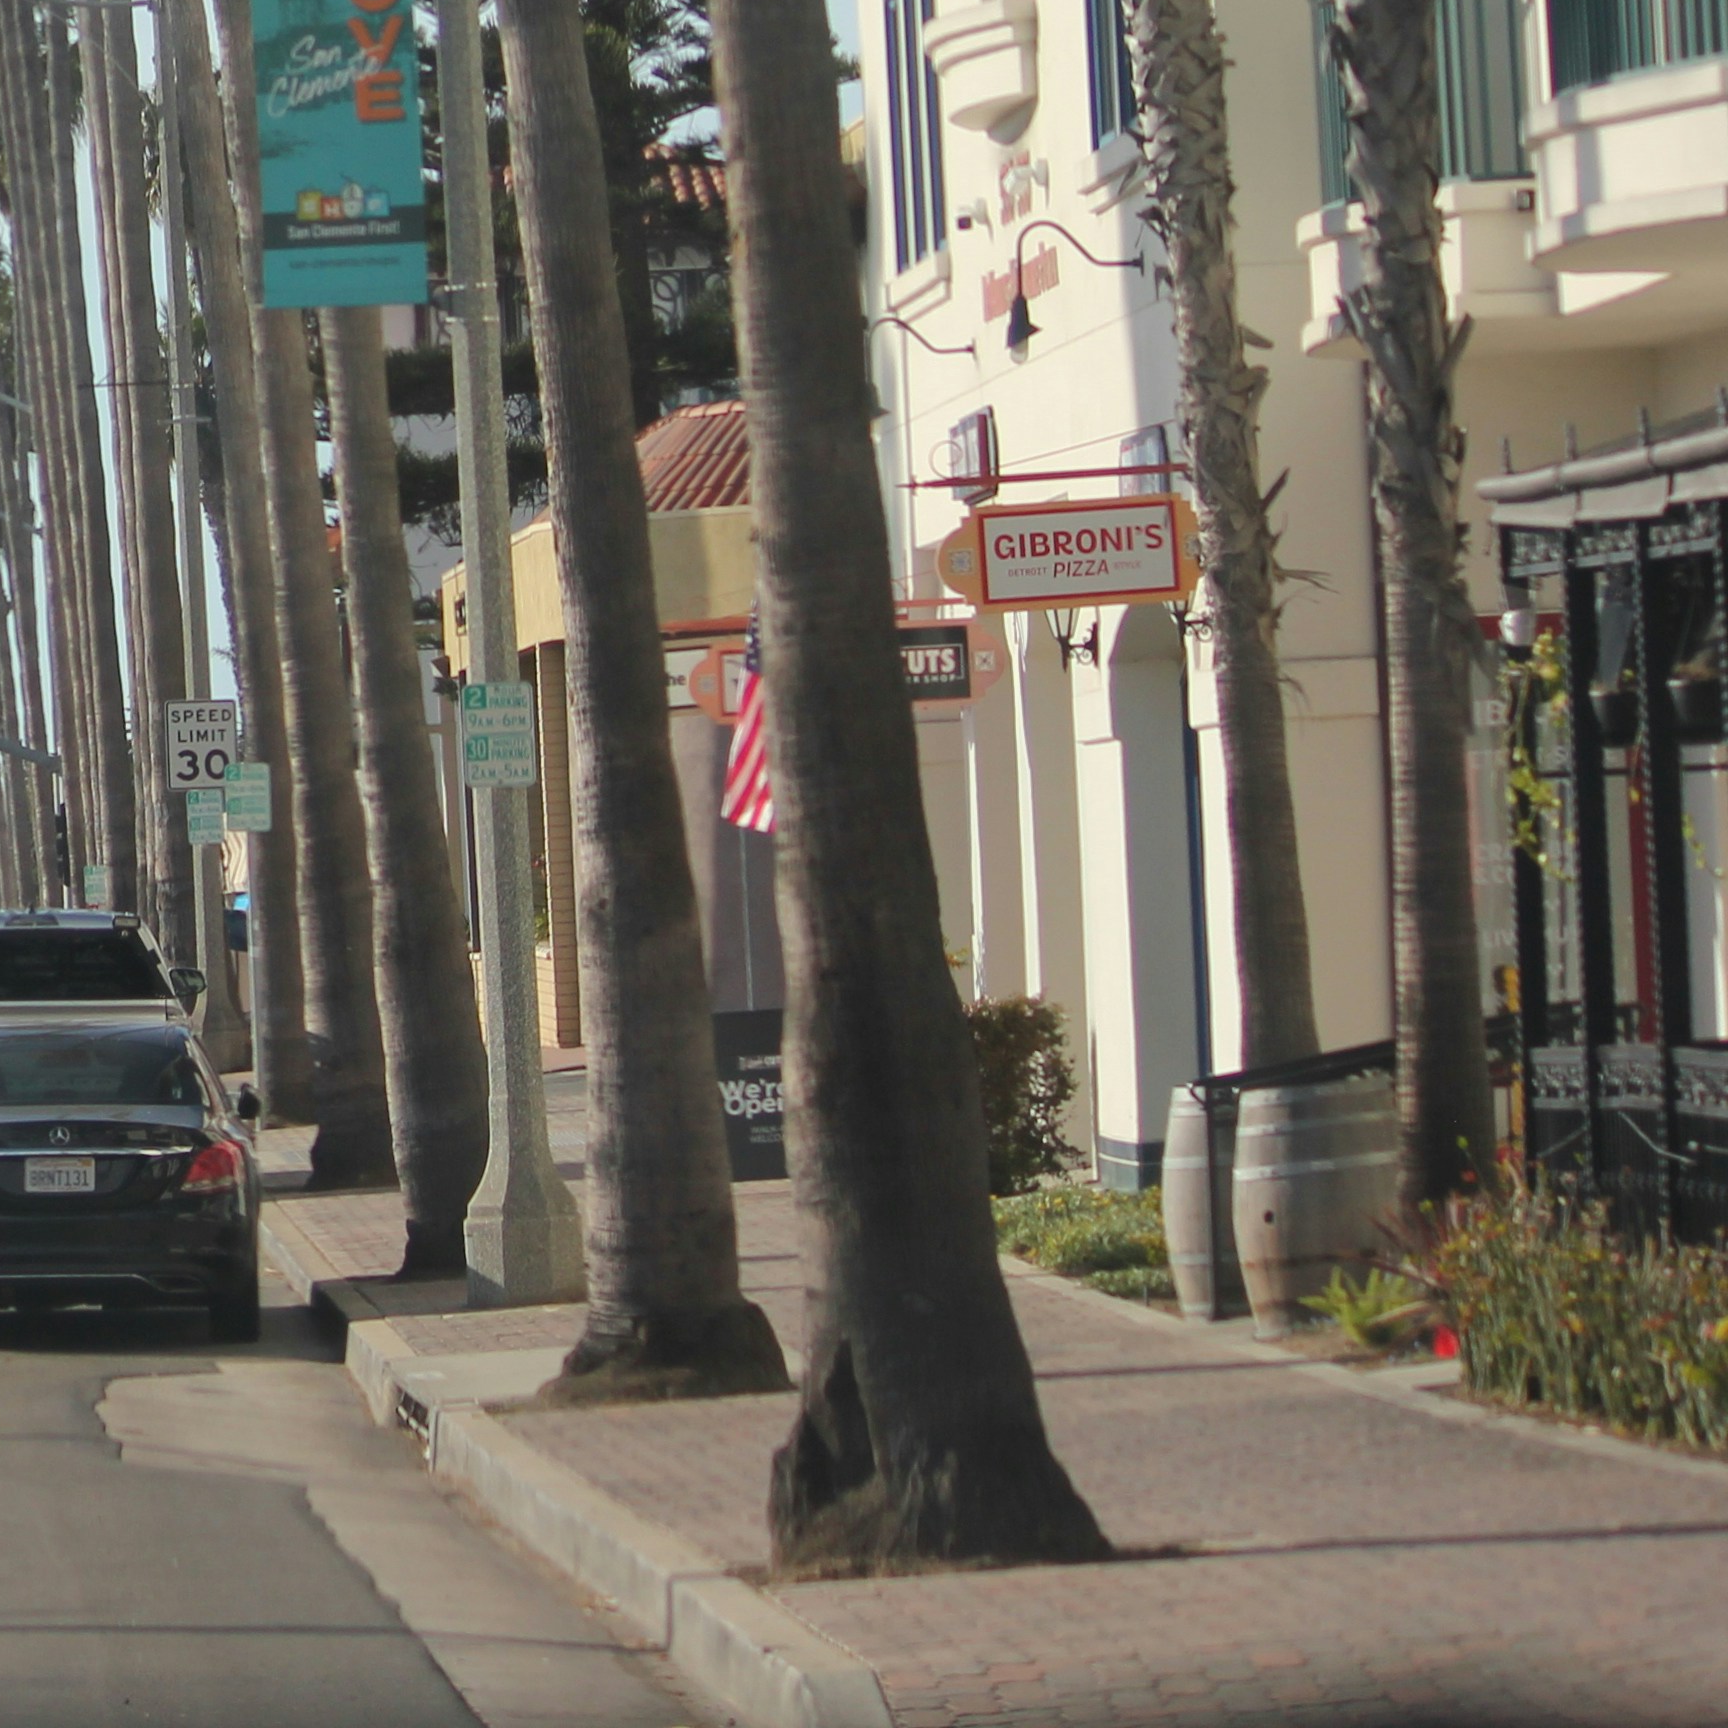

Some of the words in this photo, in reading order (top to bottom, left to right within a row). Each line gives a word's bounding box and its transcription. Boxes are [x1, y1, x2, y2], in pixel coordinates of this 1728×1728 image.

[285, 35, 342, 72] San
[267, 43, 383, 118] Clemente
[287, 225, 310, 240] San
[311, 223, 367, 237] Clemente
[368, 220, 401, 235] First!
[994, 523, 1164, 560] GIBRONI'S
[1008, 567, 1047, 578] DETROIT
[1053, 559, 1109, 578] PIZZA
[900, 647, 955, 674] UTS
[469, 687, 482, 707] 2
[171, 709, 232, 723] SPEED
[178, 729, 226, 743] LIMIT
[468, 739, 486, 760] 30
[176, 749, 230, 781] 30
